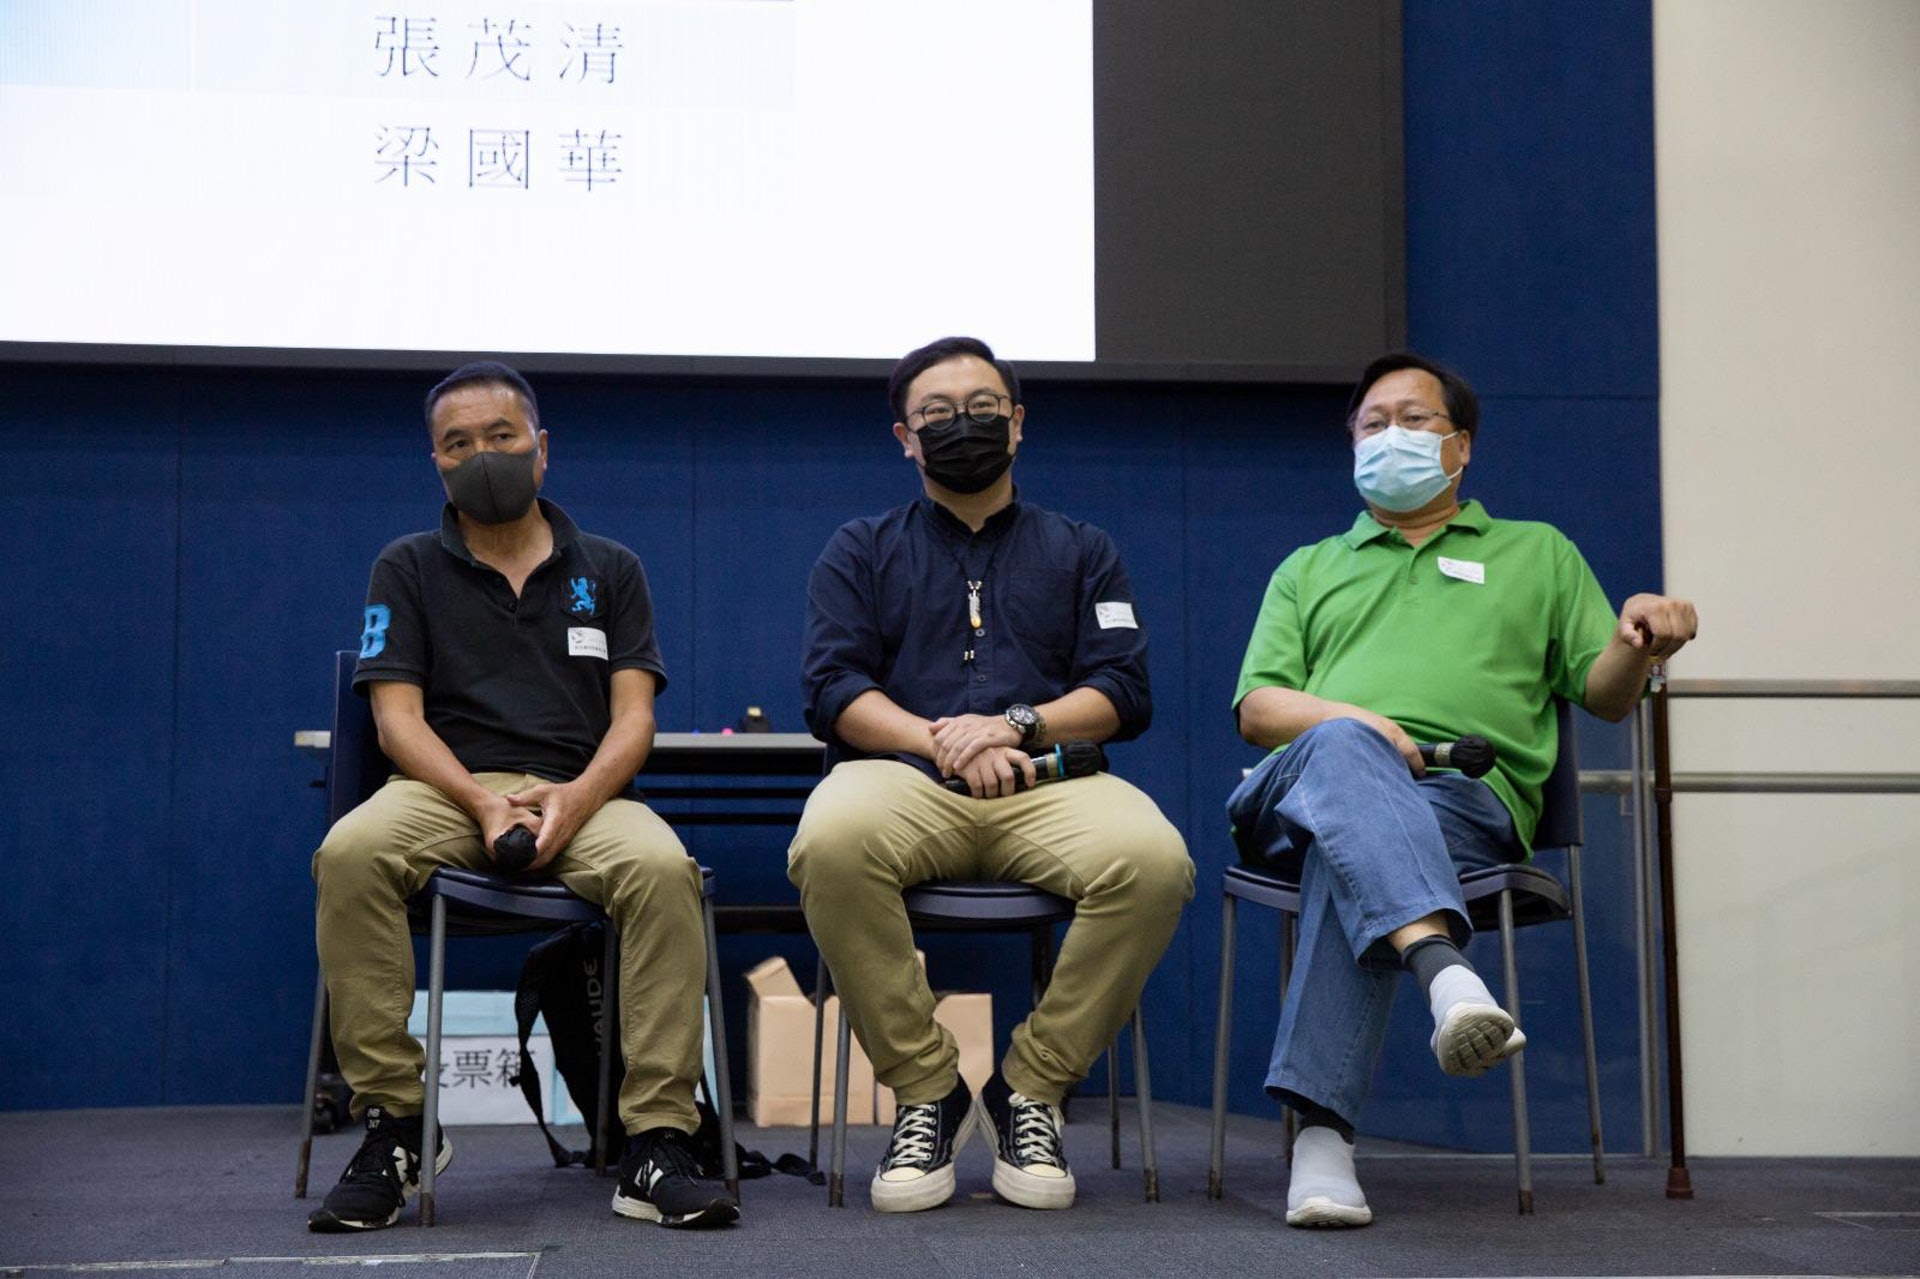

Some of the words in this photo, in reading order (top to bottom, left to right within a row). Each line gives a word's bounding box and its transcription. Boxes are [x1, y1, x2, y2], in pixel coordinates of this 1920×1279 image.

[374, 15, 624, 85] 張茂清
[374, 124, 623, 192] 梁國華
